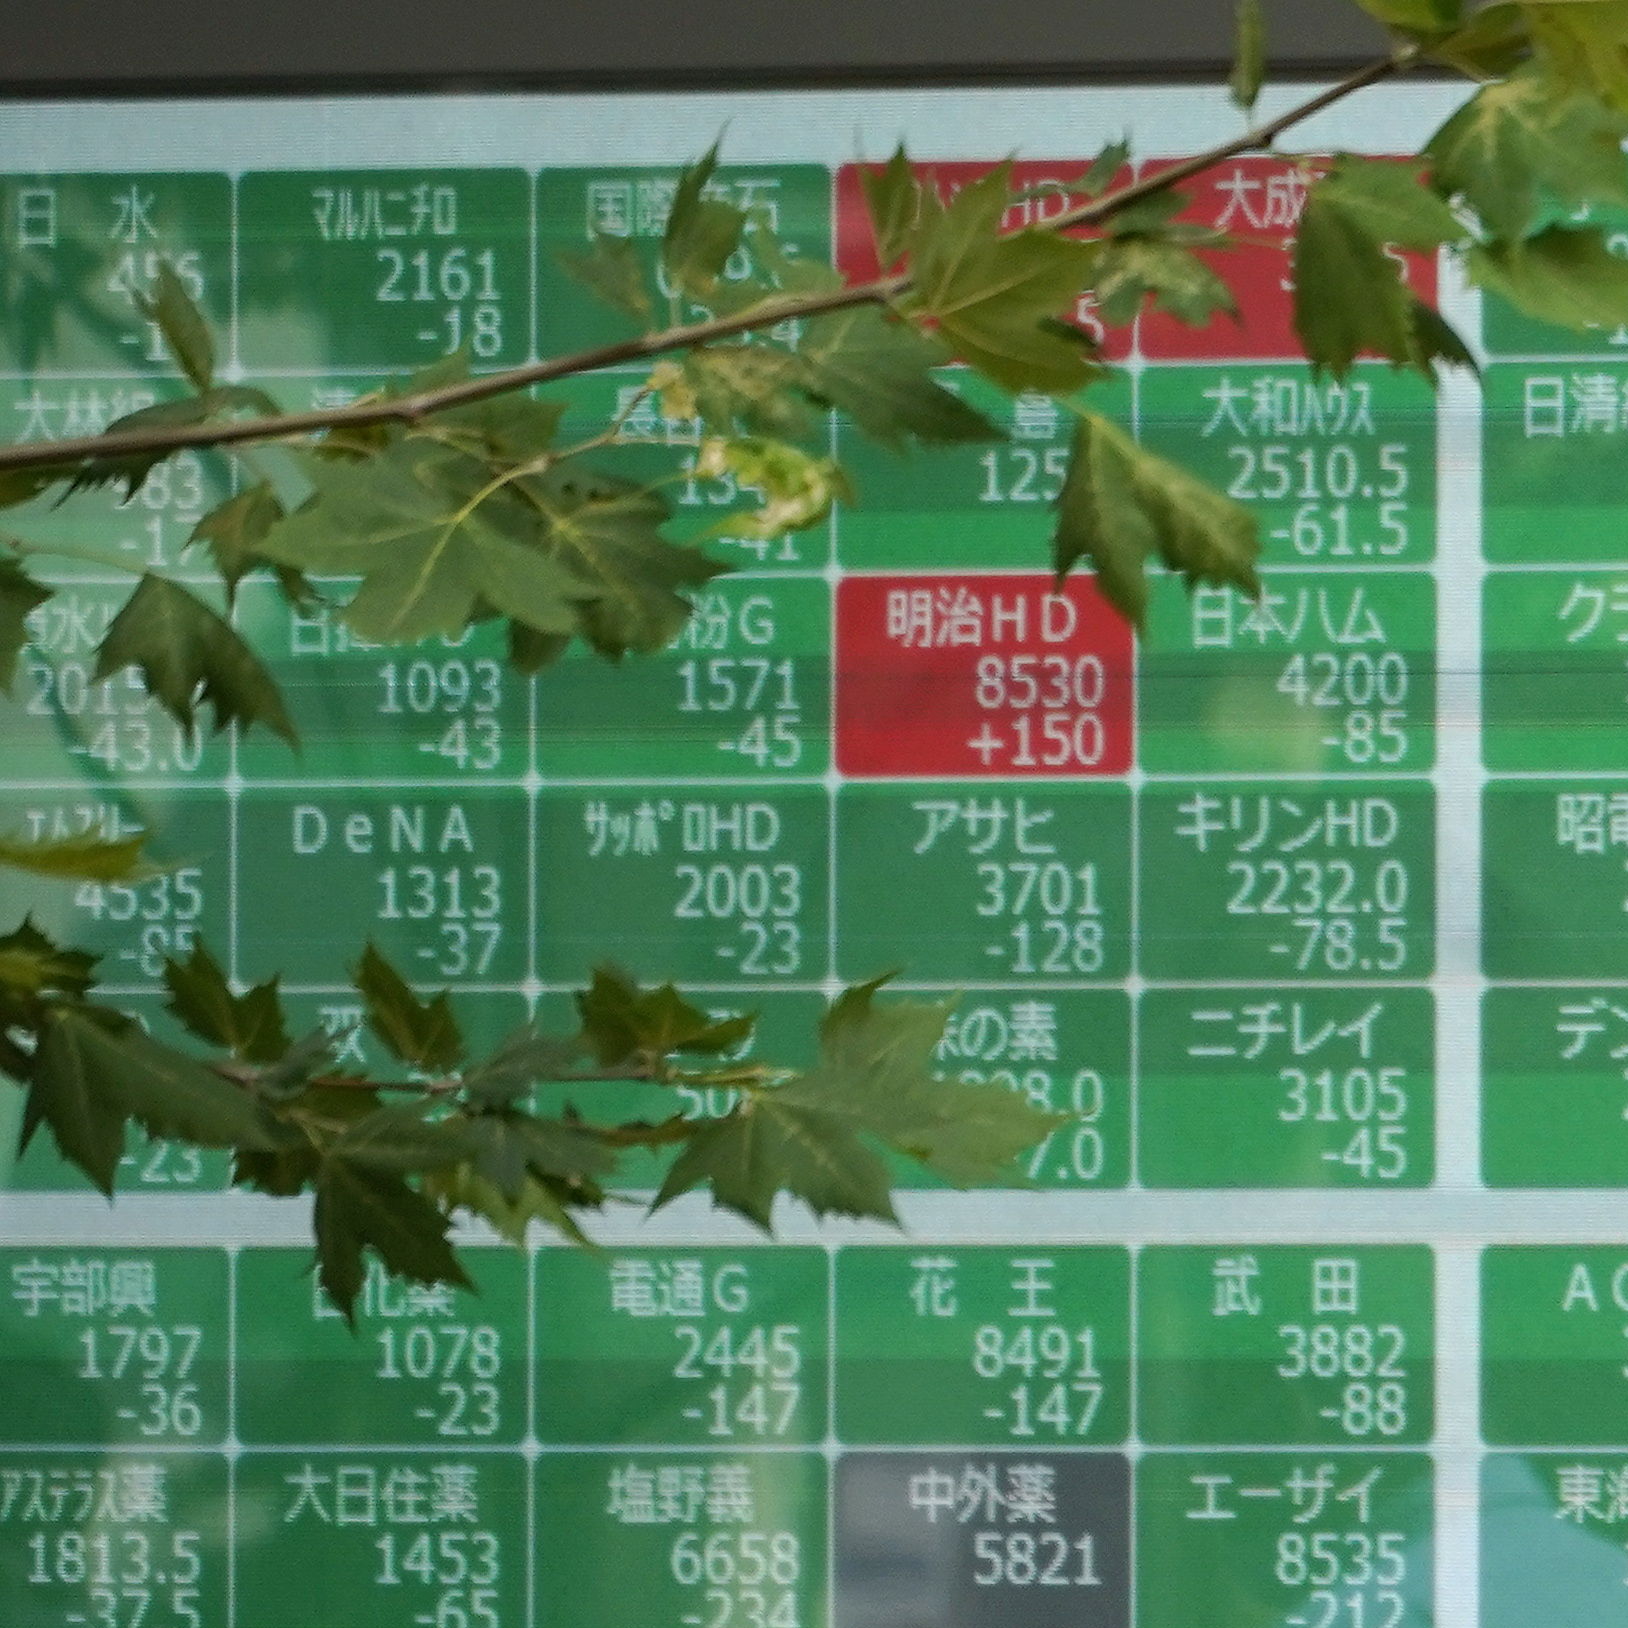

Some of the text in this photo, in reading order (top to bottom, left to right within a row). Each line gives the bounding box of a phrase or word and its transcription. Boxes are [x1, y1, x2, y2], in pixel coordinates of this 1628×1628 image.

[376, 247, 499, 302] 2161
[417, 304, 501, 358] -18
[1227, 444, 1408, 501] 2510.5
[1270, 502, 1408, 557] -61.5
[378, 661, 502, 714] 1093
[678, 659, 800, 712] 1571
[976, 654, 1104, 709] 8530
[1276, 652, 1408, 708] 4200
[417, 717, 502, 770] -43
[717, 714, 801, 767] -45
[968, 712, 1105, 766] +150
[1321, 711, 1408, 765] -85
[913, 799, 1054, 854] アサヒ
[1176, 793, 1398, 852] キリンHD
[378, 865, 500, 920] 1313
[674, 863, 800, 921] 2003
[977, 862, 1100, 916] 3701
[1227, 860, 1407, 914] 2232.0
[417, 922, 502, 976] -37
[715, 920, 800, 975] -23
[985, 919, 1103, 974] -128
[1270, 916, 1406, 971] -78.5
[1188, 1002, 1382, 1059] ニチレイ
[1279, 1067, 1406, 1122] 3105
[1320, 1126, 1406, 1178] -45
[79, 1325, 202, 1379] 1797
[117, 1383, 202, 1439] -36
[910, 1464, 1055, 1523] 中外薬
[1187, 1464, 1380, 1523] エーザイ
[376, 1531, 498, 1586] 1453
[975, 1532, 1100, 1585] 5821
[1275, 1532, 1406, 1589] 8535
